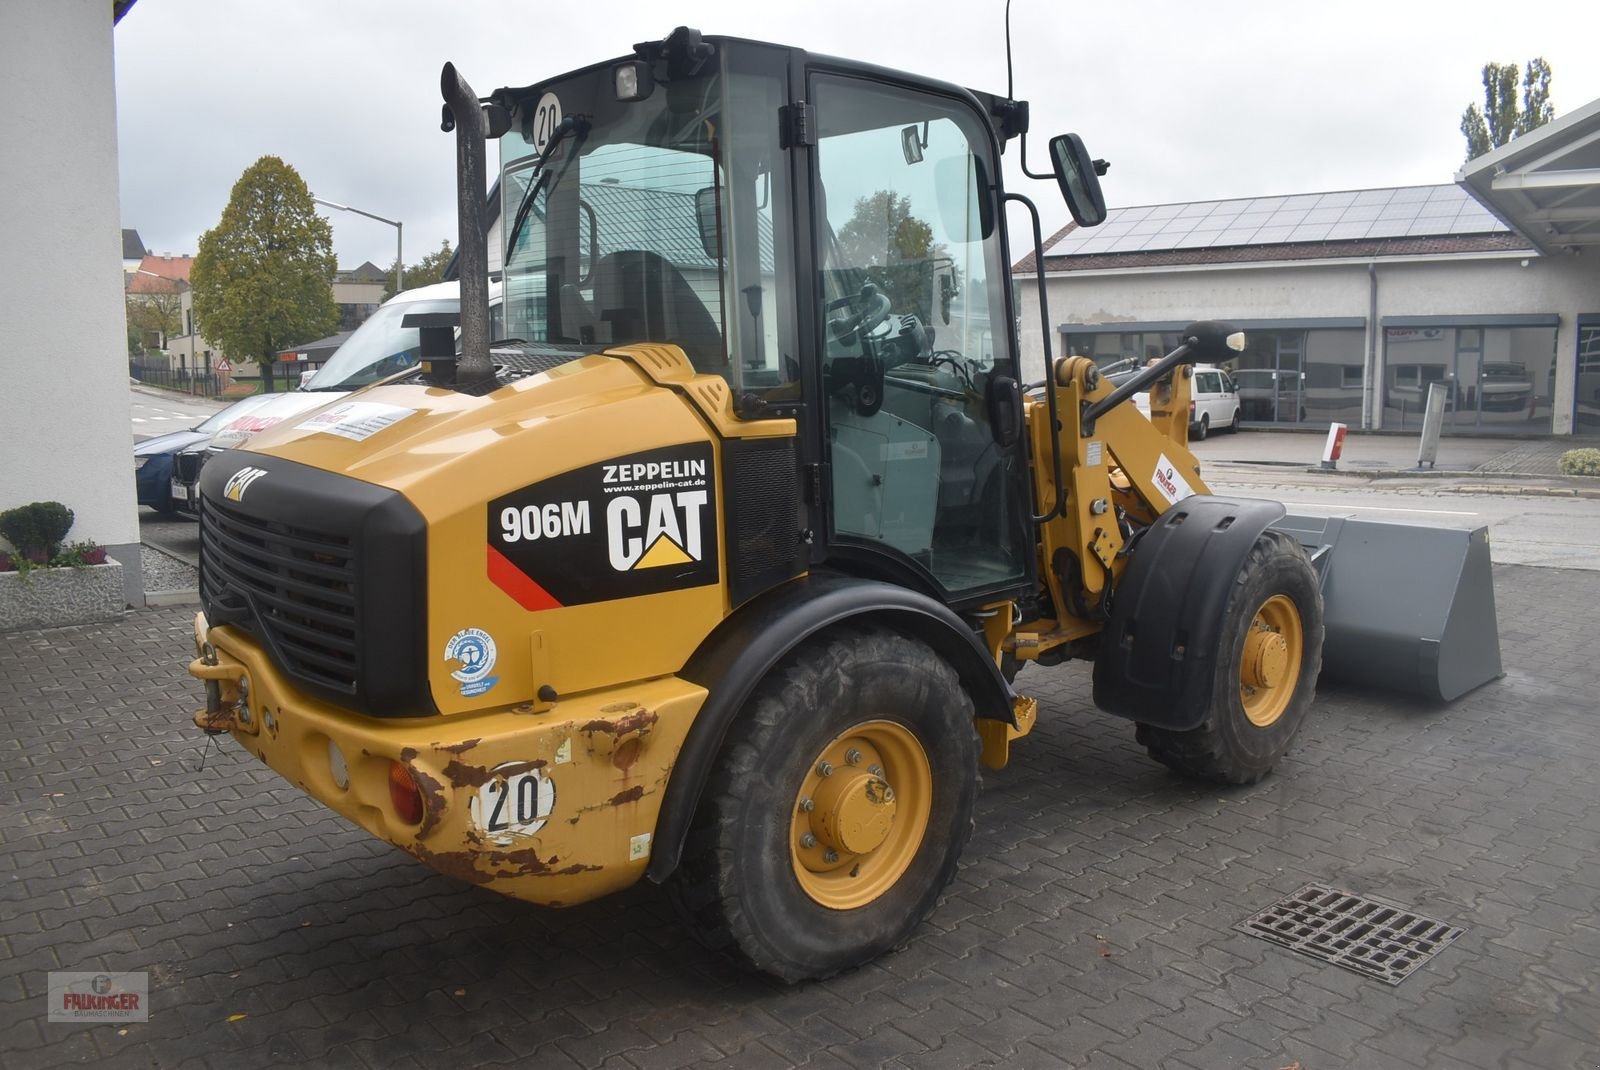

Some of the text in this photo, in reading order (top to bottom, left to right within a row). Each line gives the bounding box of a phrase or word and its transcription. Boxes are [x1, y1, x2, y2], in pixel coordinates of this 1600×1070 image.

[538, 104, 556, 146] 20
[224, 466, 268, 502] CAT
[602, 459, 705, 483] ZEPPELIN
[603, 478, 706, 493] www.zeppelin-cat.de
[500, 500, 591, 543] 906M
[606, 490, 707, 571] CAT
[488, 775, 539, 832] 20
